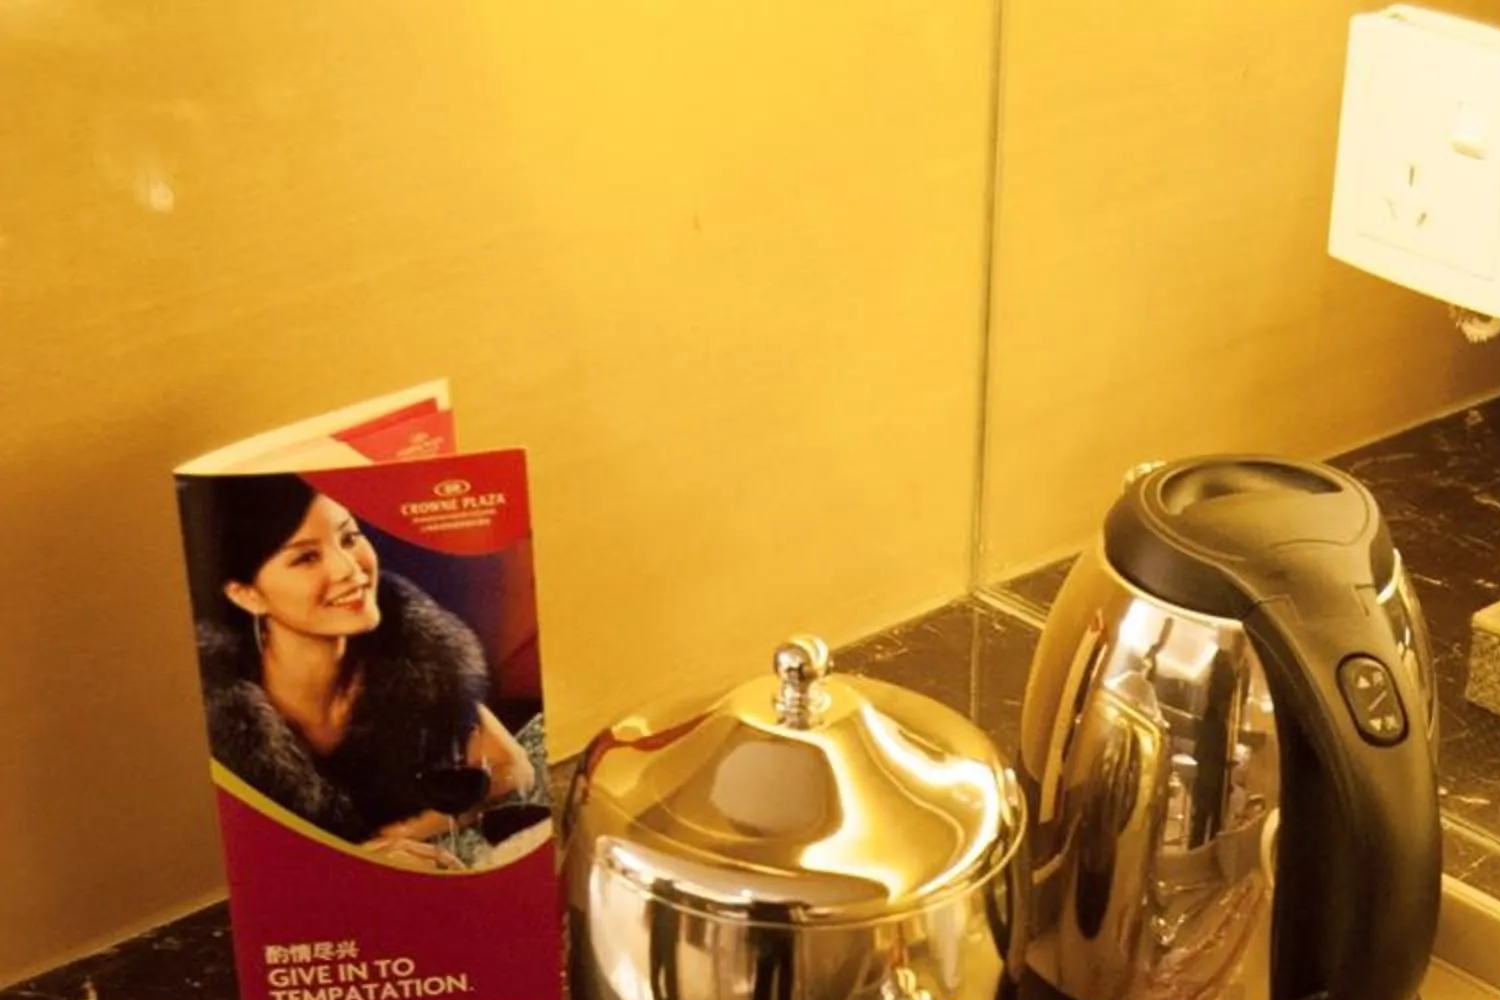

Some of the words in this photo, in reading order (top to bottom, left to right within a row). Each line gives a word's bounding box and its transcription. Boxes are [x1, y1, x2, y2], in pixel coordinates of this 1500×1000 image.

[400, 498, 458, 517] CROWNE
[461, 493, 506, 509] PLAZA
[267, 964, 333, 988] GIVE
[337, 961, 369, 982] IN
[373, 957, 415, 979] TO
